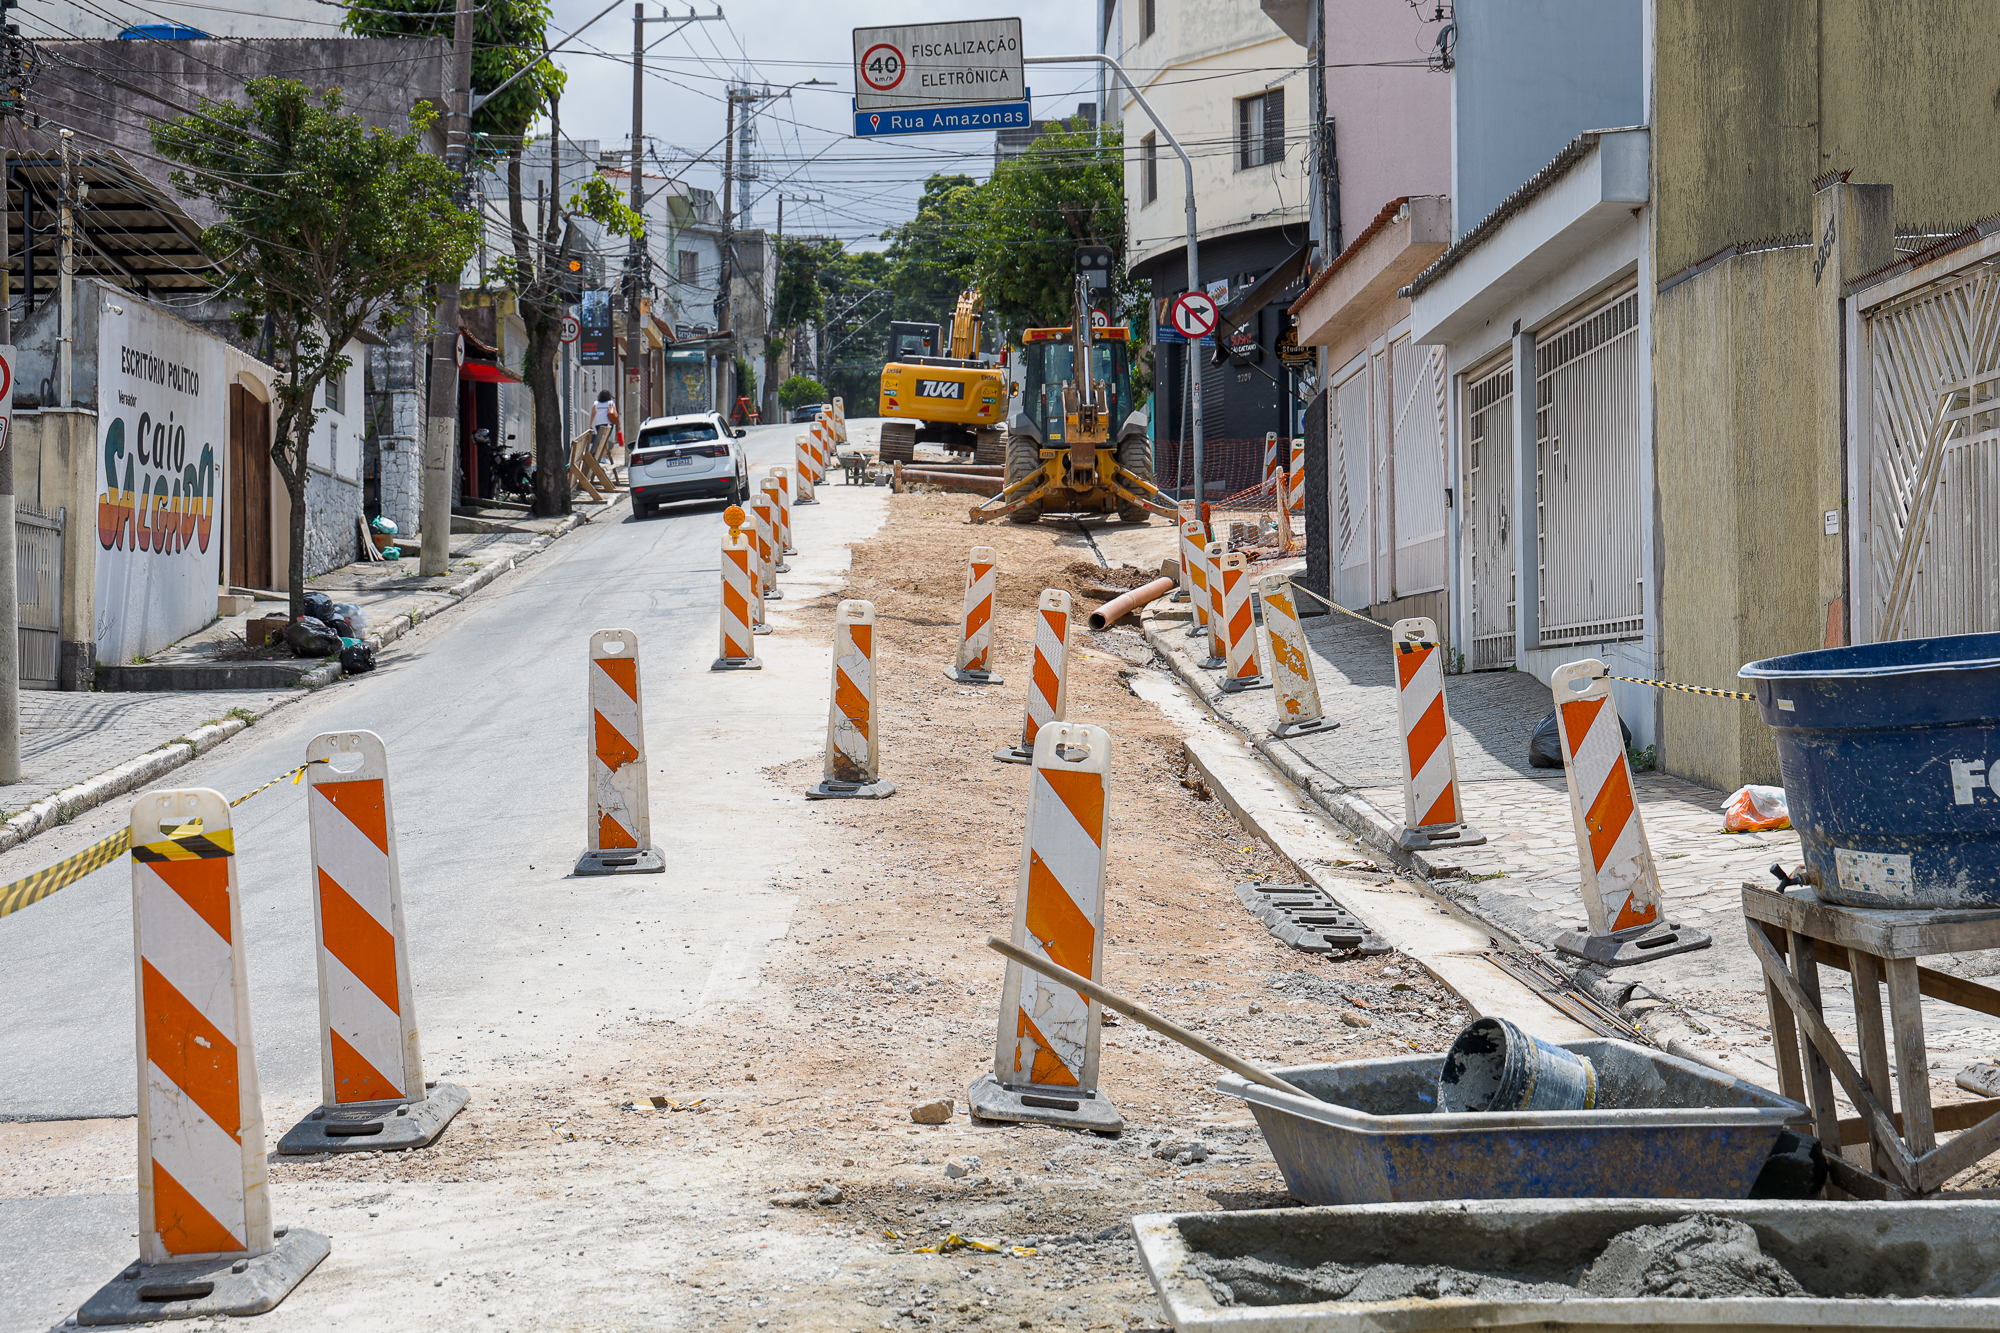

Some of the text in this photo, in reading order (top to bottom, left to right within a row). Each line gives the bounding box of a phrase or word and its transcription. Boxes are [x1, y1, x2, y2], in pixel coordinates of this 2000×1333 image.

[912, 35, 1017, 58] FISCALIZAÇÃO
[868, 56, 898, 74] 40
[874, 75, 894, 83] km/h
[921, 68, 1009, 87] ELETRÔNICA
[891, 110, 1024, 129] Rua Amazonas
[1813, 212, 1836, 288] 2253
[1282, 345, 1305, 353] Studio
[121, 345, 199, 397] ESCRITÓRIO POLÍTICO
[118, 389, 138, 408] Vereador
[922, 380, 959, 399] TUKA
[137, 410, 186, 473] Caio
[98, 417, 214, 556] SALGADO
[1949, 758, 2000, 805] F
